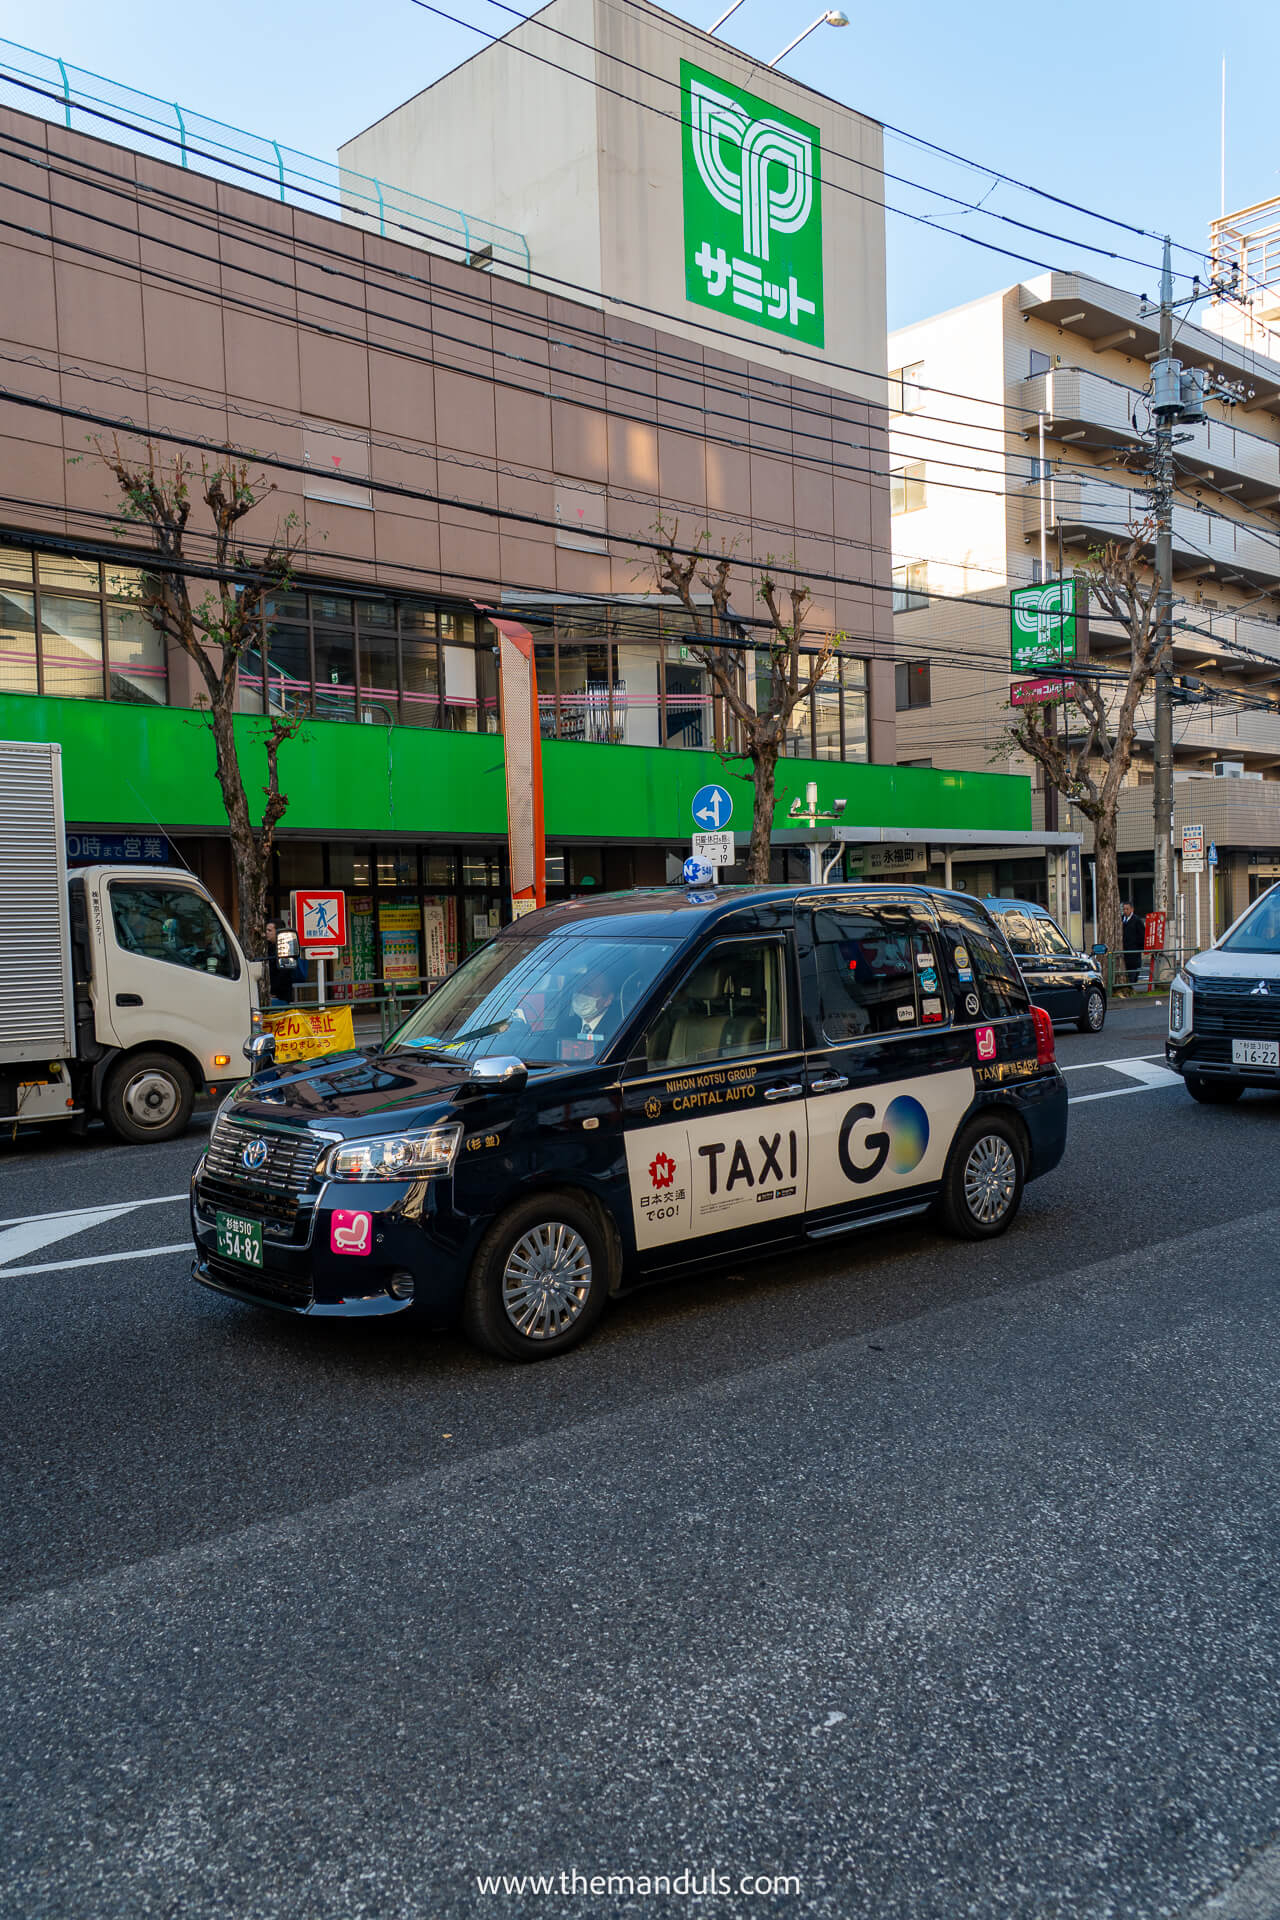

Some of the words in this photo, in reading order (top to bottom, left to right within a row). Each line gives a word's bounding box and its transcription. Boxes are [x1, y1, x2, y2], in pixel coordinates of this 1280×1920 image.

[695, 241, 815, 326] サミット
[883, 848, 914, 863] 永福町
[309, 1015, 337, 1034] 禁止
[1244, 1049, 1277, 1064] 16-22
[666, 1079, 696, 1094] NIHON
[697, 1072, 726, 1088] KOTSU
[727, 1067, 757, 1082] GROUP
[672, 1091, 723, 1111] CAPITAL
[725, 1084, 756, 1101] AUTO
[698, 1130, 797, 1195] TAXI
[640, 1188, 686, 1208] 日本交通
[646, 1205, 680, 1222] でGO!
[226, 1217, 252, 1235] 杉並510
[225, 1231, 260, 1264] 54-82
